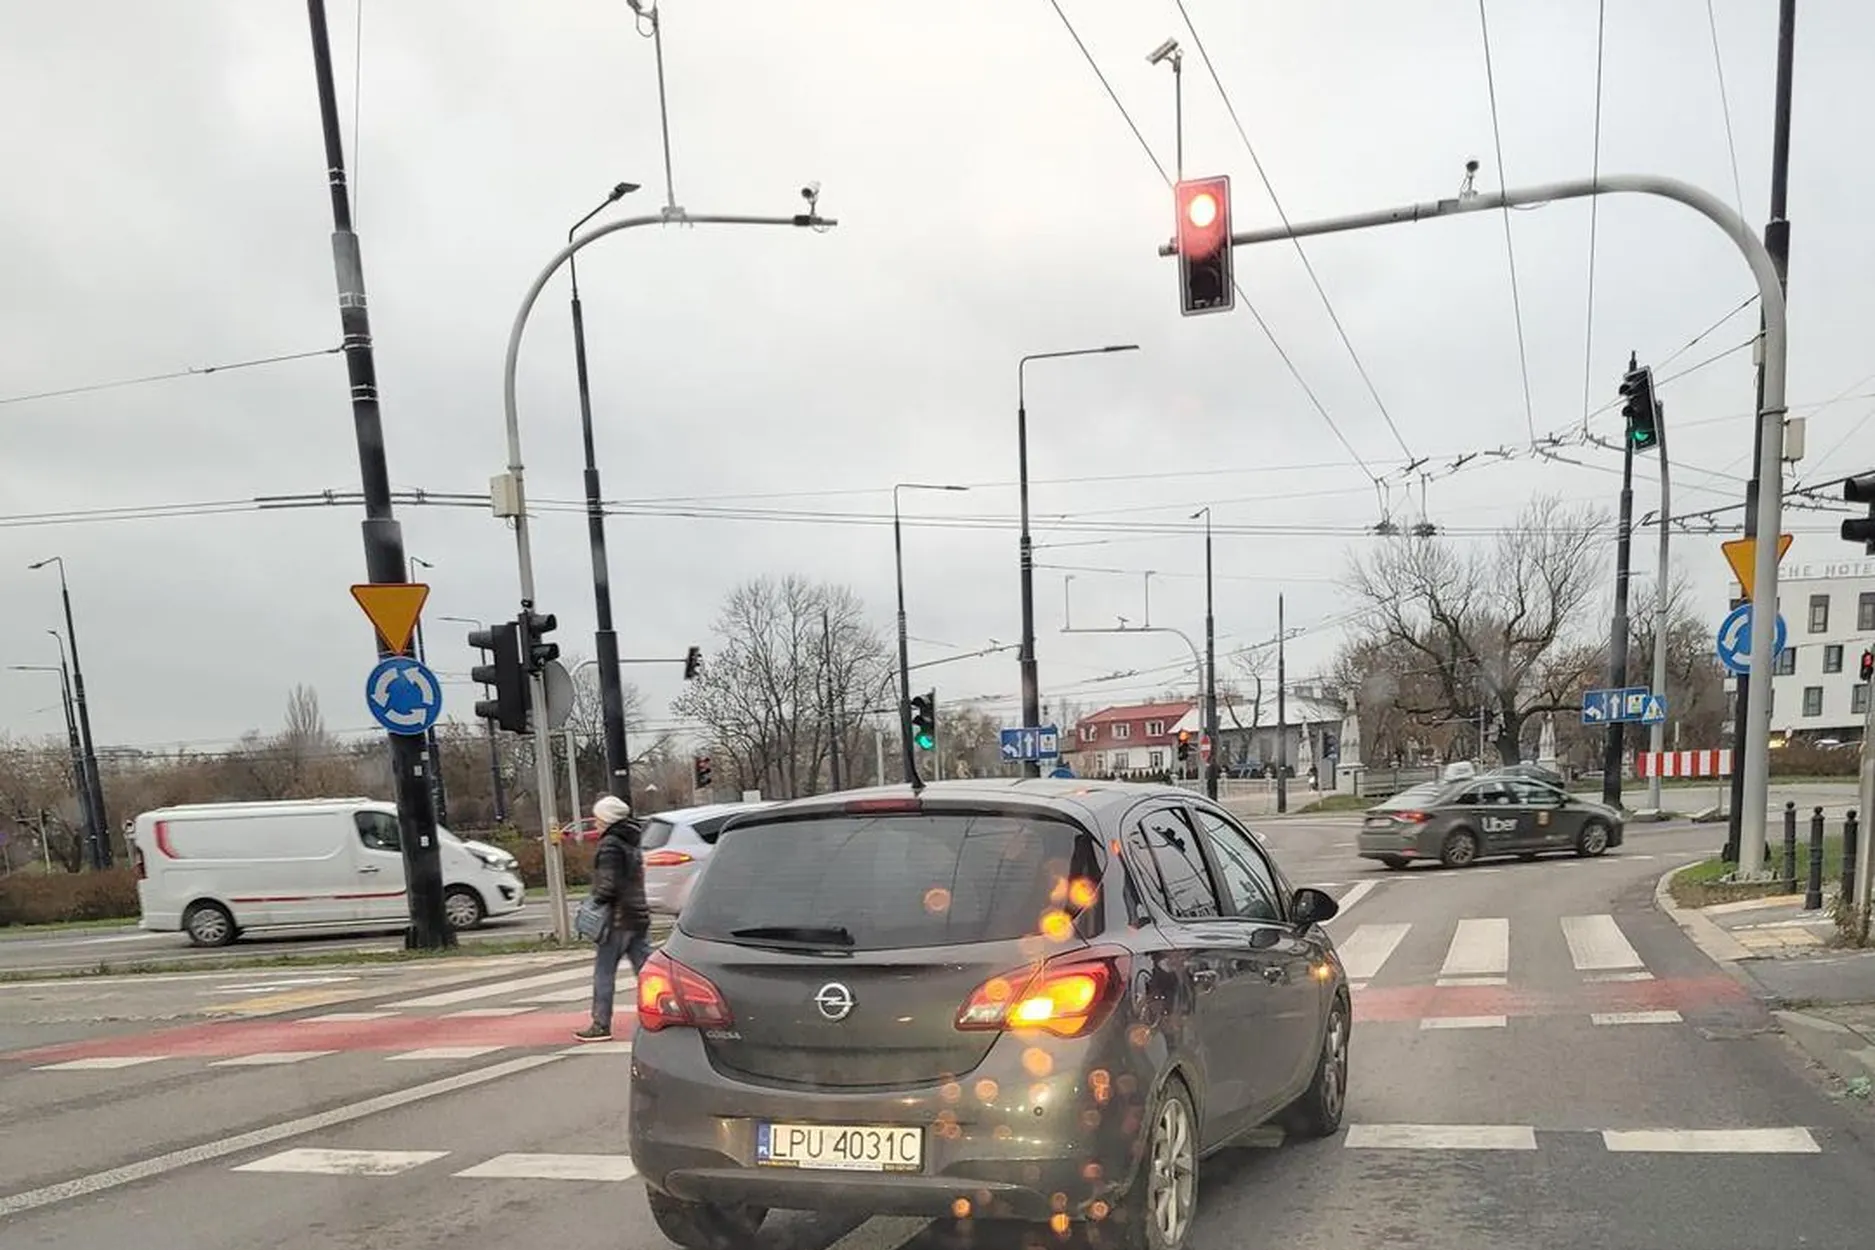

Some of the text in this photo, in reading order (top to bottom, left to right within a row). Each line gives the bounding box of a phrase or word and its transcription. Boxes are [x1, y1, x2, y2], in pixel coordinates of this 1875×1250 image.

[1825, 563, 1875, 577] HOTE
[1481, 816, 1519, 832] Uber
[773, 1128, 915, 1161] LPU 4031C
